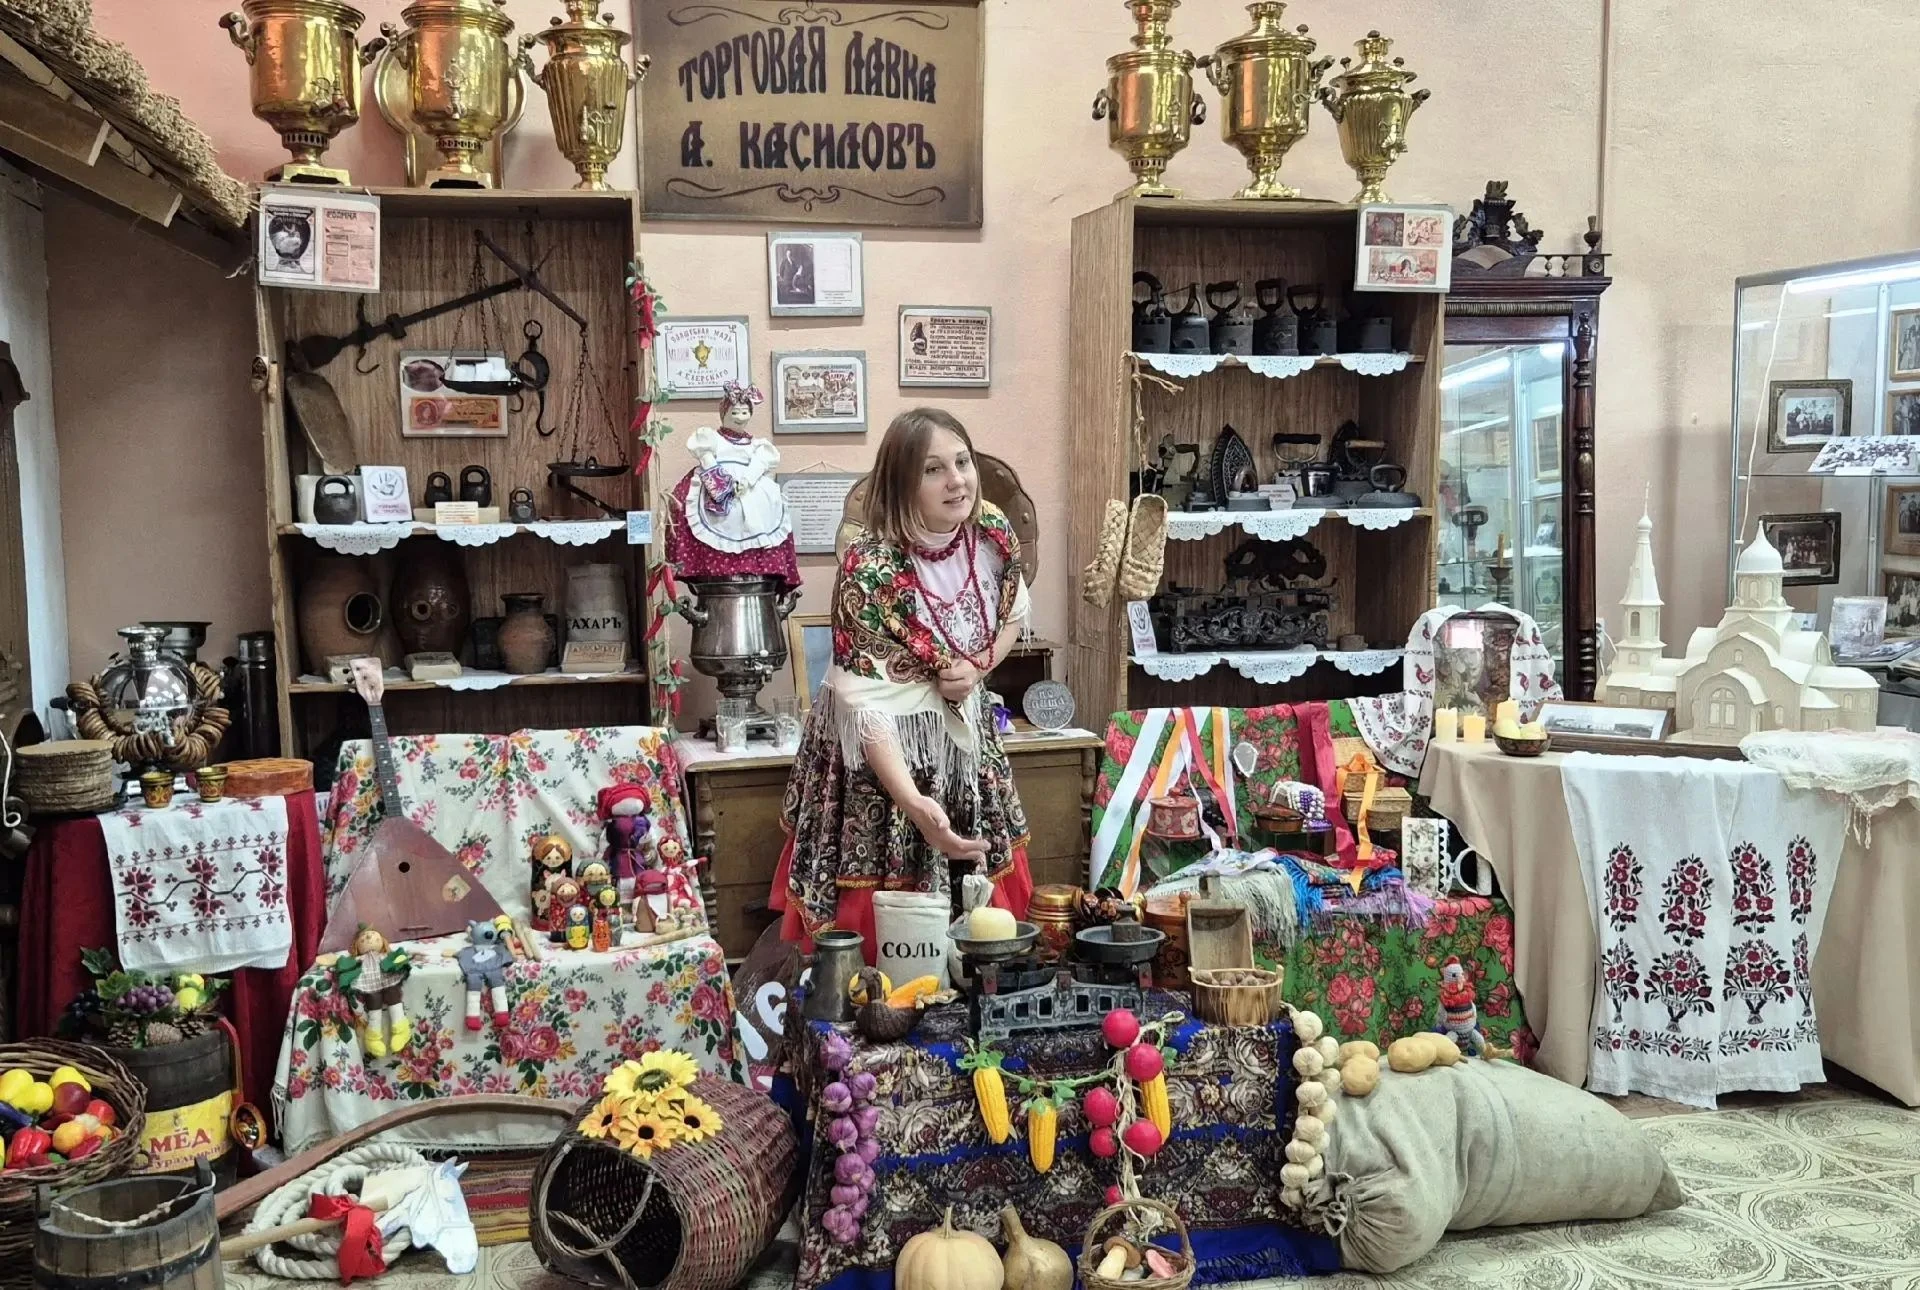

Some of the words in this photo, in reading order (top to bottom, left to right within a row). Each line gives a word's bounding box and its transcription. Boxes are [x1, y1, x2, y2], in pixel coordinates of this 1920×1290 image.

[678, 26, 826, 102] ТОРГОВАЯ
[845, 31, 937, 104] ЛАВКА
[681, 120, 714, 168] А.
[739, 121, 936, 172] КАСИЛОВЪ
[881, 941, 941, 959] СОЛЬ
[149, 1127, 211, 1153] МЁД
